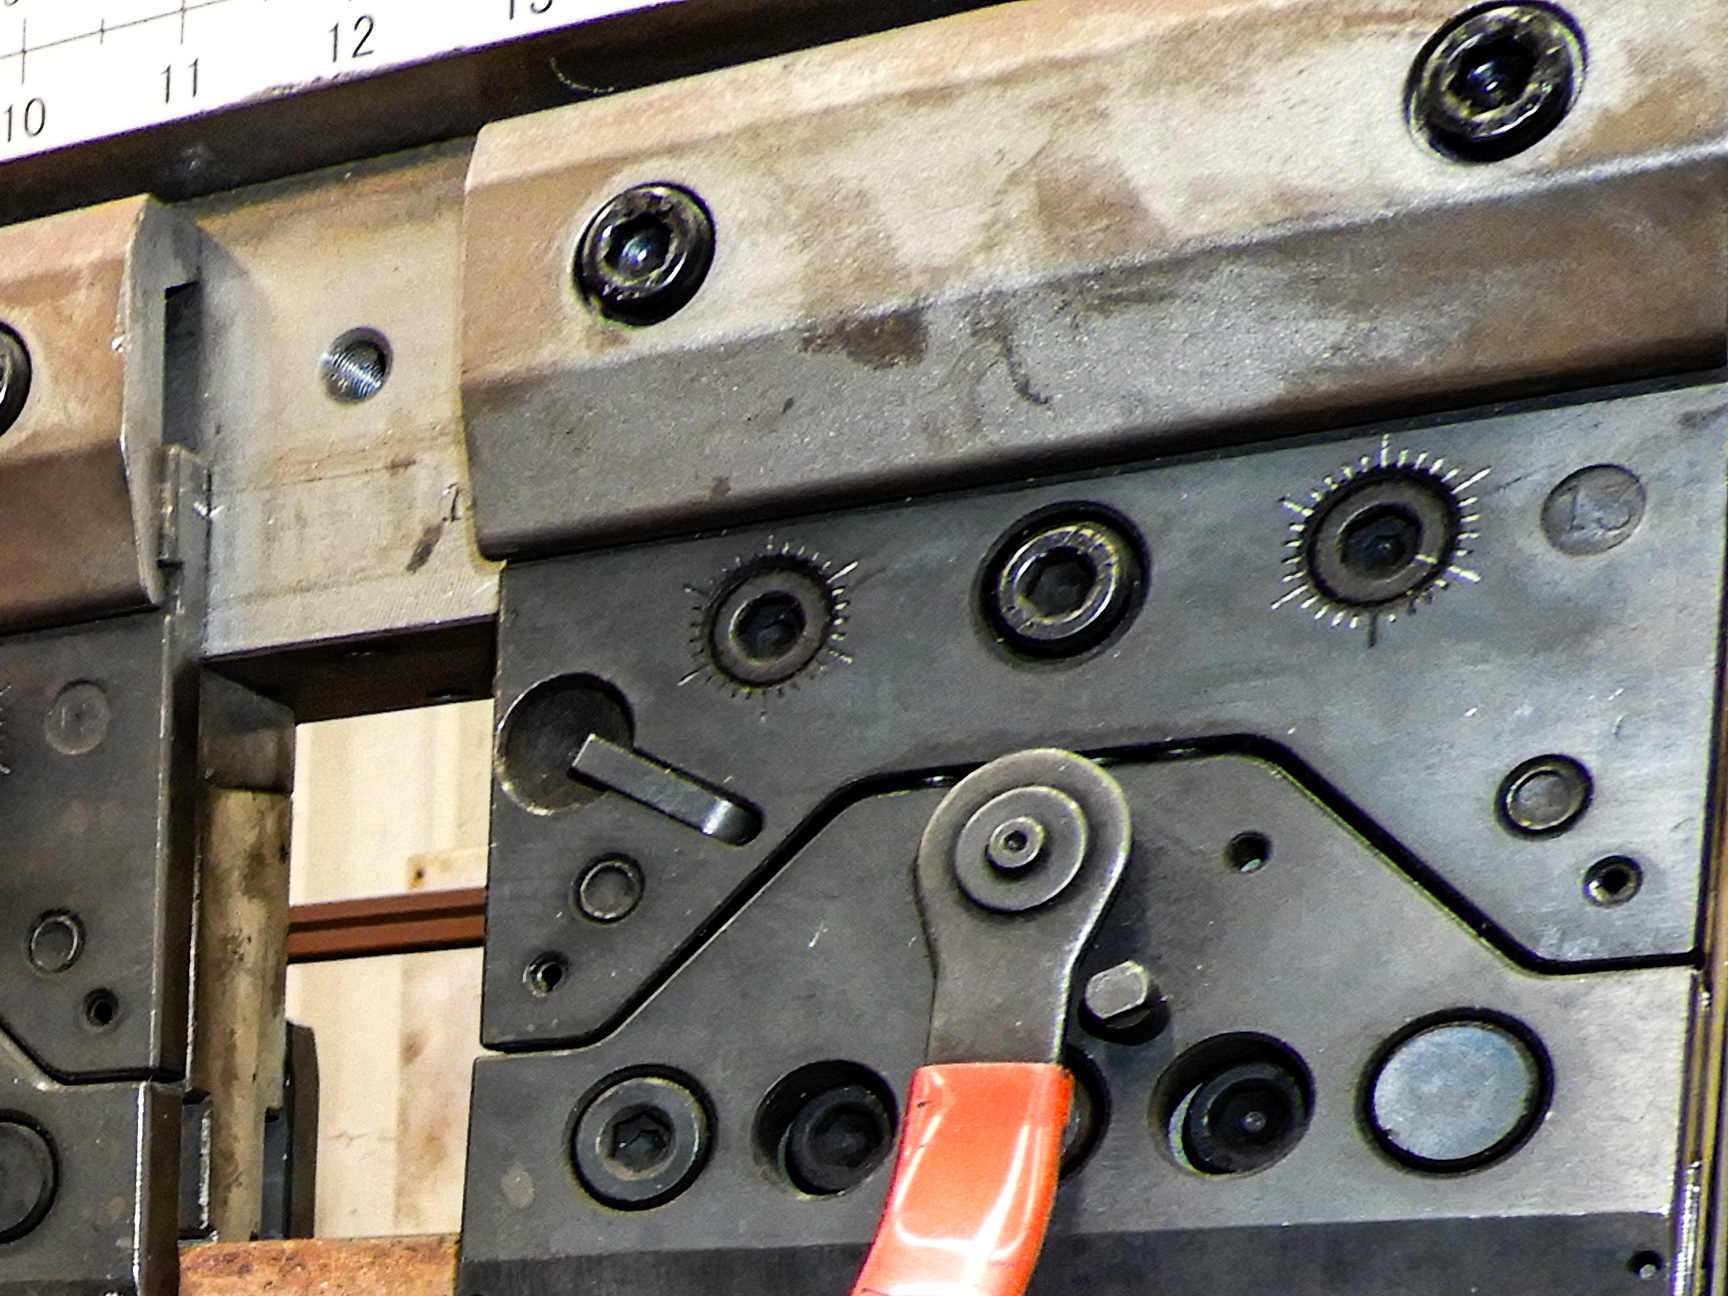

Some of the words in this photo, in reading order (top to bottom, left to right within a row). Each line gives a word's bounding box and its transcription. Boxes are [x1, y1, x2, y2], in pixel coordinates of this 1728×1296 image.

[2, 98, 47, 143] 10
[161, 58, 199, 104] 11
[326, 17, 376, 63] 12
